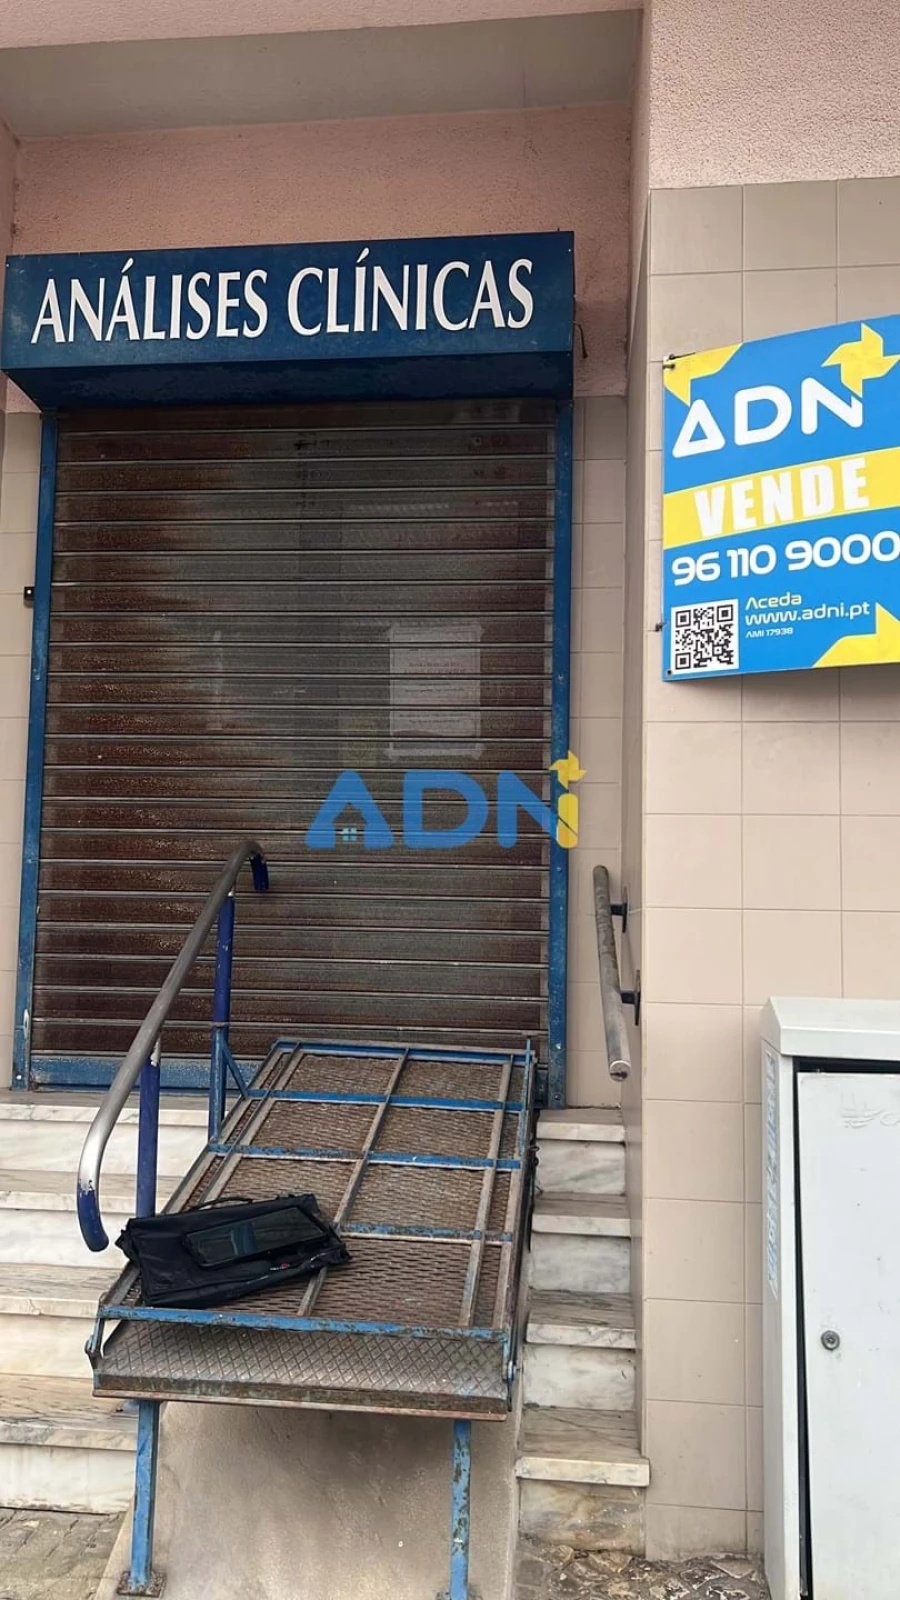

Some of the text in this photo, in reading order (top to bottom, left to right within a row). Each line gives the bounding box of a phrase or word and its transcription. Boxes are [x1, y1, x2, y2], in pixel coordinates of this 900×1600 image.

[31, 247, 534, 344] ANÁLISES CLÍNICAS
[693, 457, 870, 538] VENDE
[671, 530, 900, 586] 96 110 9000
[745, 592, 802, 610] Aceda
[745, 602, 870, 626] www.adni.pt
[745, 627, 794, 638] AMI 17938
